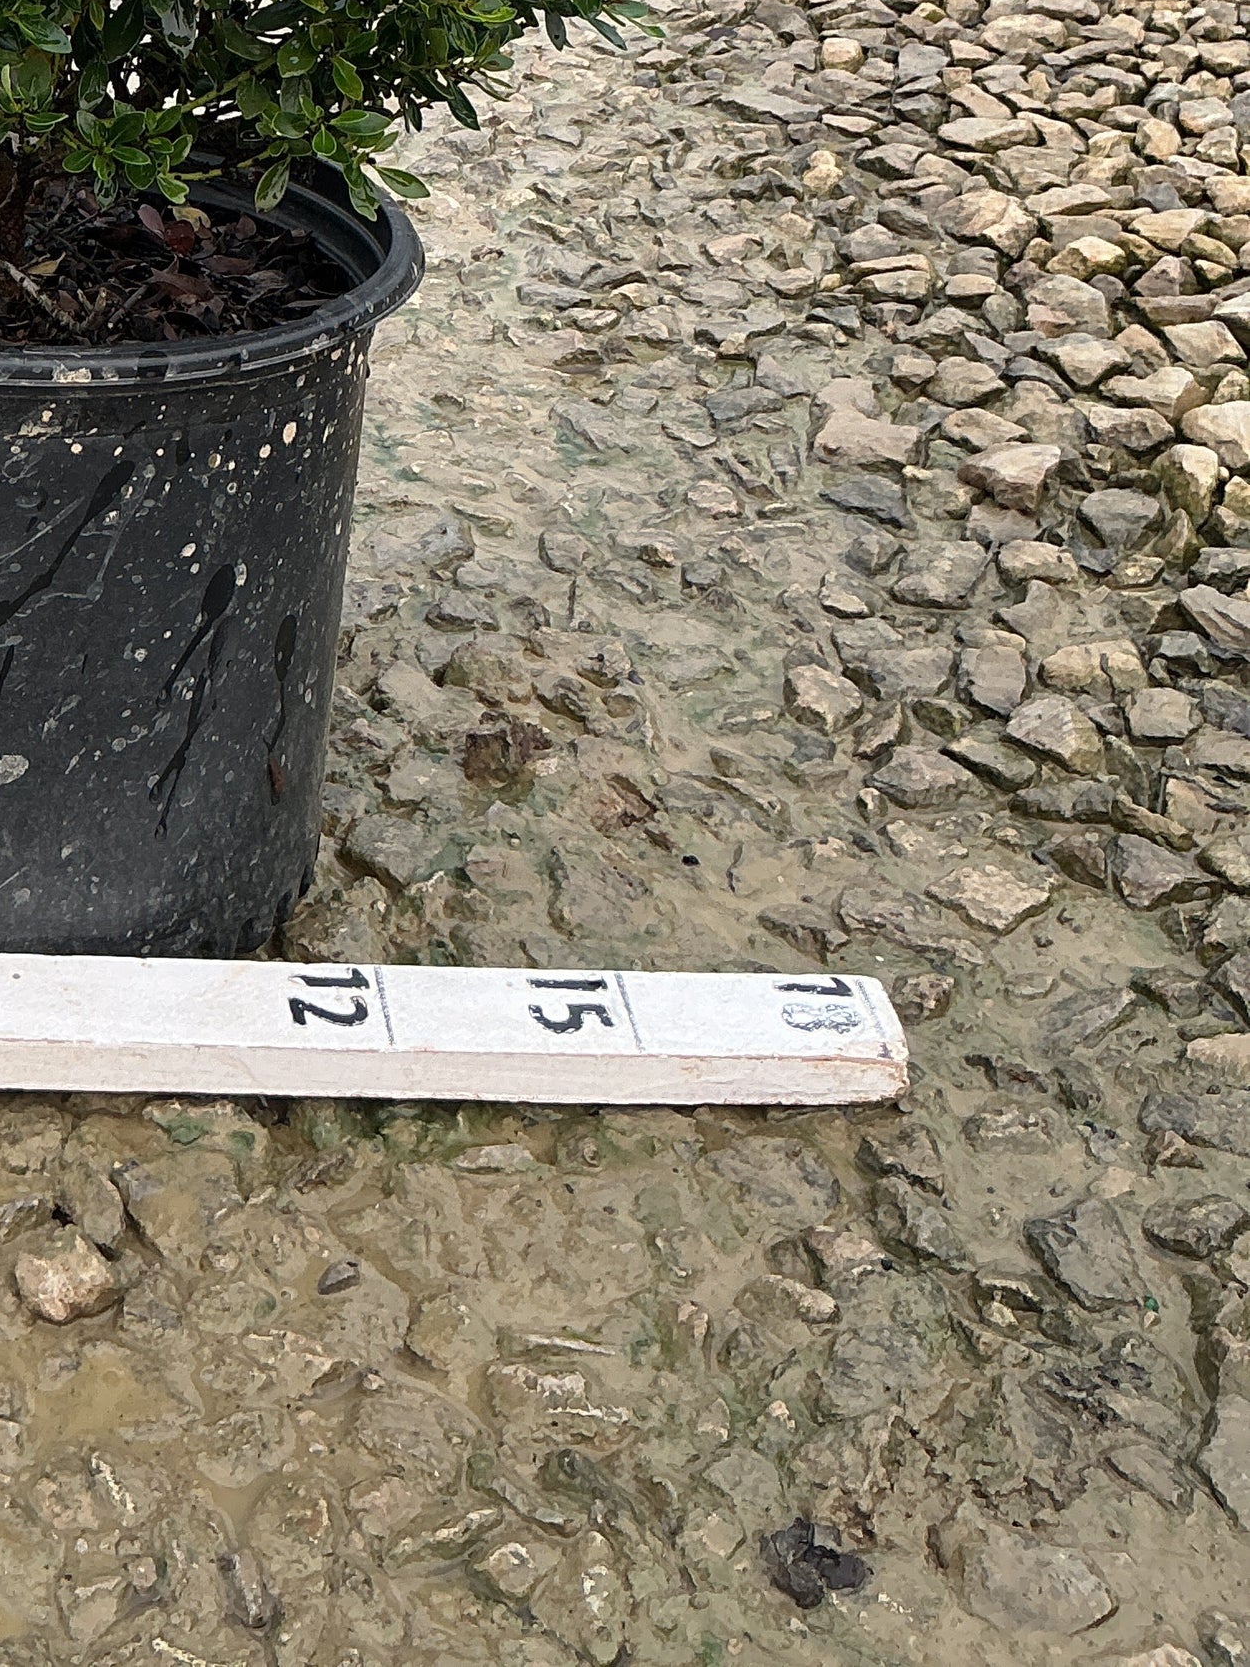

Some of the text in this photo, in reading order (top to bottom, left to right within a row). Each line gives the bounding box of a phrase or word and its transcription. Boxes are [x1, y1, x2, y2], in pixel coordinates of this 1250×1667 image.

[288, 967, 371, 1026] 12
[526, 976, 614, 1034] 15
[772, 976, 862, 1034] 18
